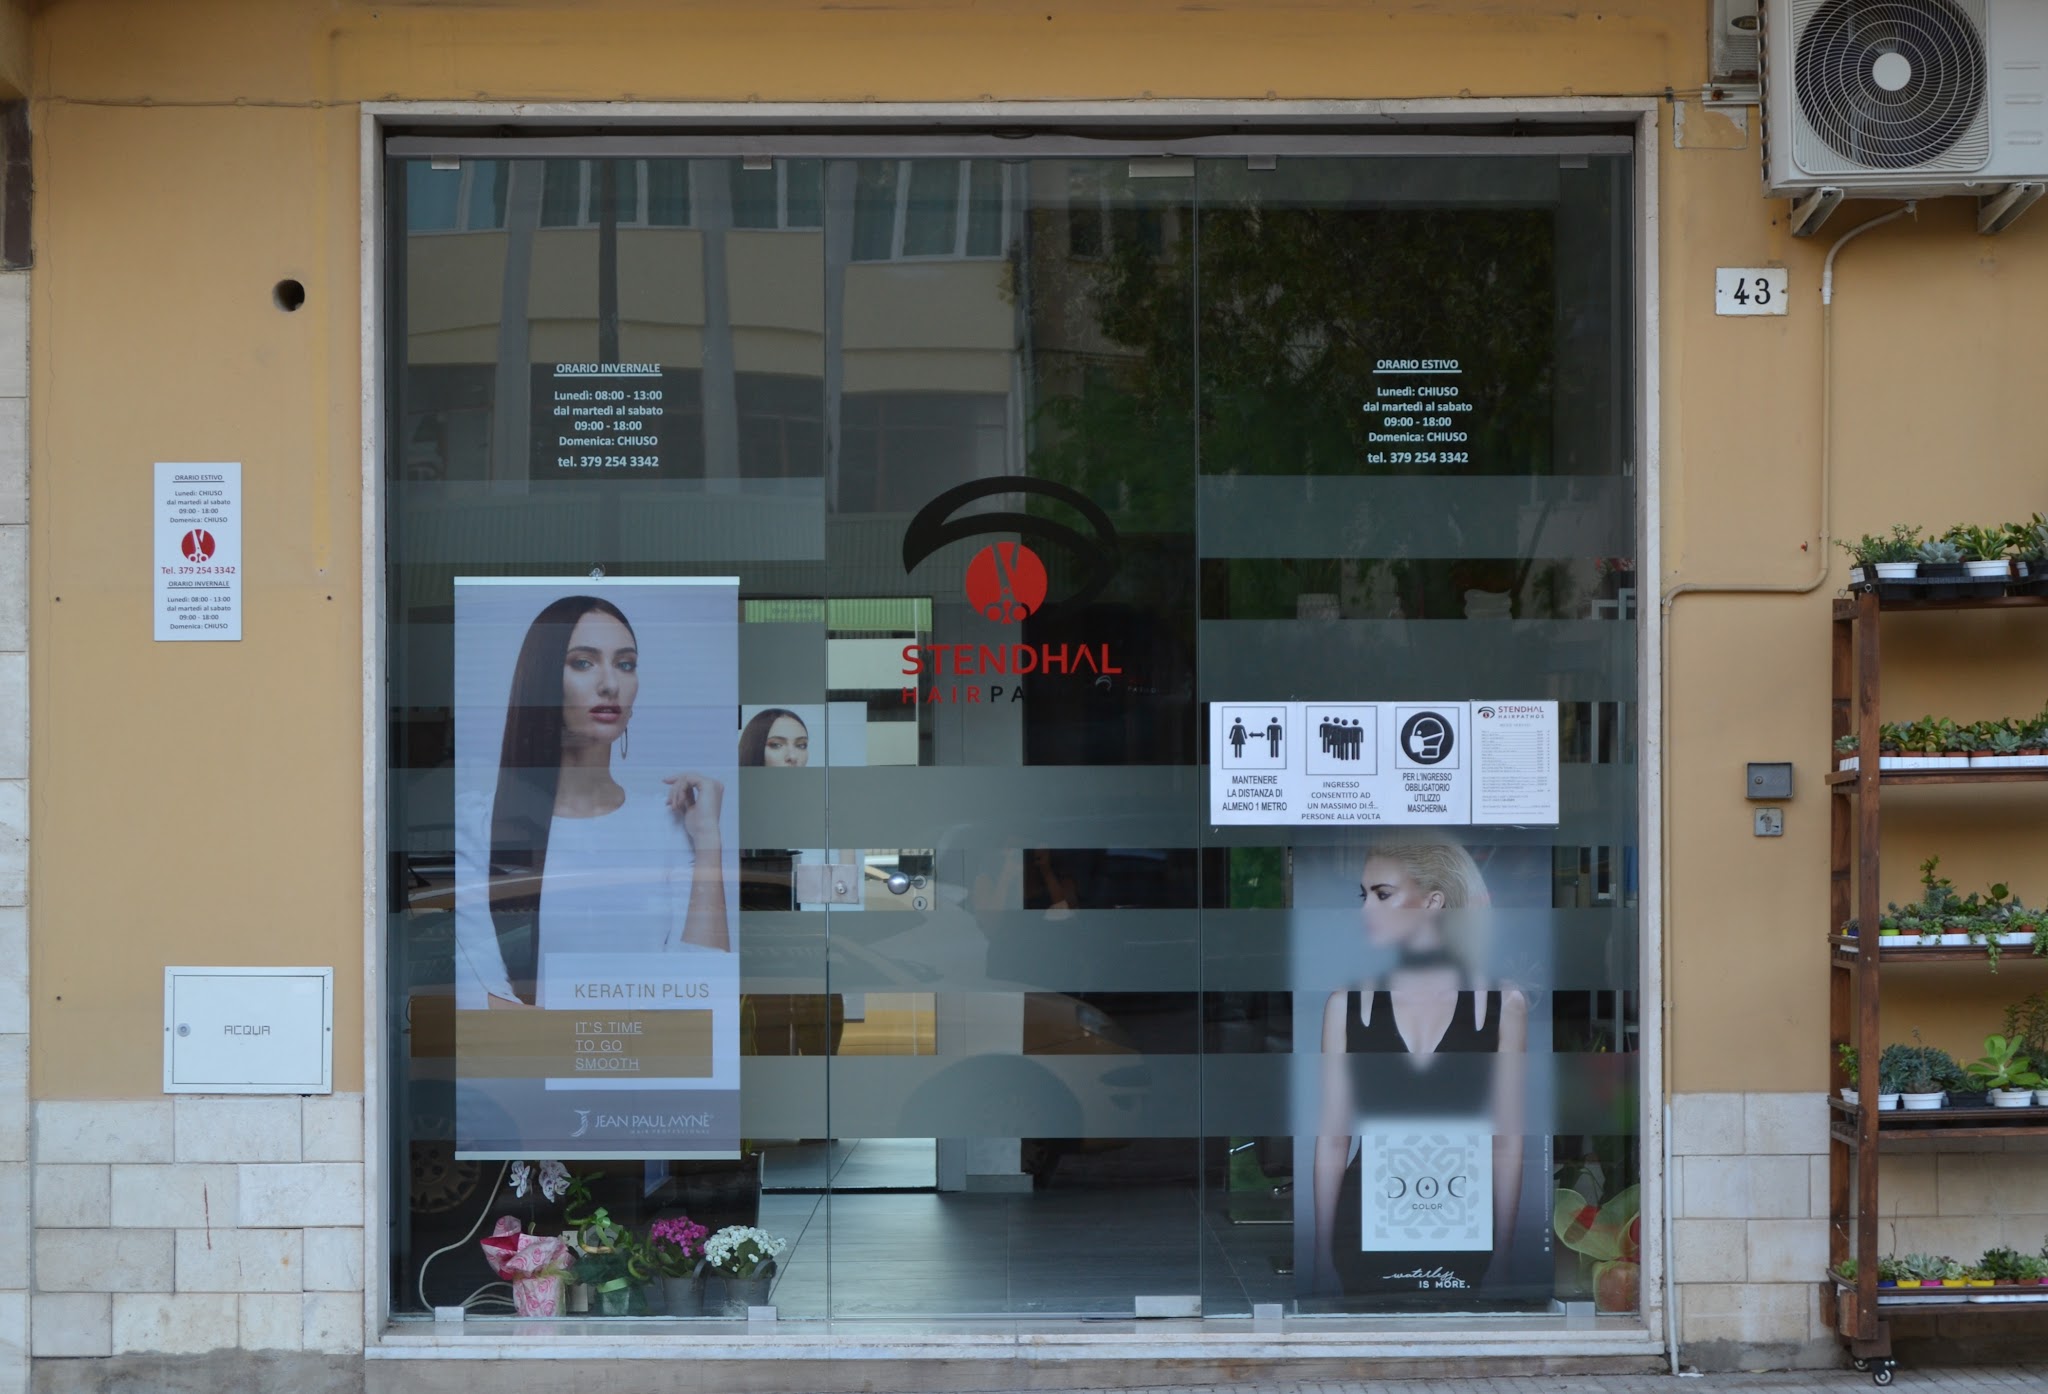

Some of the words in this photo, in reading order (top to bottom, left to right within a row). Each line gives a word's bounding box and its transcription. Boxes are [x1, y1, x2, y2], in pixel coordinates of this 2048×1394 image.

[1733, 277, 1771, 305] 43
[556, 363, 599, 373] ORARIO
[600, 363, 661, 373] INVERNALE
[1376, 359, 1419, 369] ORARIO
[1421, 359, 1459, 369] ESTIVO
[554, 390, 593, 401] Lunedì:
[594, 390, 624, 400] 08:00
[633, 390, 663, 400] 13:00
[1377, 386, 1416, 397] Lunedì:
[1417, 386, 1459, 396] CHIUSO
[553, 405, 570, 416] dal
[572, 405, 614, 416] martedì
[615, 405, 626, 416] al
[627, 405, 664, 416] sabato
[1363, 401, 1379, 412] dal
[1381, 401, 1423, 412] martedì
[1425, 401, 1435, 412] al
[1437, 401, 1473, 412] sabato
[574, 421, 604, 431] 09:00
[612, 421, 643, 431] 18:00
[1384, 416, 1414, 427] 09:00
[1422, 416, 1452, 427] 18:00
[558, 436, 615, 446] Domenica:
[616, 436, 658, 446] CHIUSO
[1368, 431, 1424, 442] Domenica:
[1426, 431, 1468, 442] CHIUSO
[557, 456, 577, 468] tel.
[580, 456, 602, 467] 379
[604, 456, 627, 467] 254
[629, 456, 660, 467] 3342
[1367, 452, 1387, 463] tel.
[1390, 452, 1412, 463] 379
[1414, 452, 1437, 463] 254
[1439, 452, 1469, 463] 3342
[161, 566, 176, 575] Tel.
[178, 566, 194, 574] 379
[196, 566, 212, 574] 254
[214, 566, 236, 574] 3342
[901, 643, 1123, 675] STENDHAL
[901, 685, 1026, 704] HAIRPA
[1498, 705, 1544, 713] STENDHAL
[1231, 775, 1278, 785] MANTENERE
[1402, 772, 1415, 781] PER
[1416, 772, 1453, 781] L'INGRESSO
[1226, 788, 1237, 798] LA
[1238, 788, 1274, 798] DISTANZA
[1275, 788, 1283, 798] DI
[1404, 783, 1450, 792] OBBLIGATORIO
[1311, 791, 1358, 799] CONSENTITO
[1360, 791, 1371, 799] AD
[1414, 793, 1441, 802] UTILIZZO
[1222, 801, 1254, 811] ALMENO
[1261, 801, 1288, 811] METRO
[1320, 802, 1358, 810] MASSIMO
[1407, 804, 1448, 813] MASCHERINA
[575, 983, 656, 998] KERATIN
[663, 983, 710, 998] PLUS
[224, 1025, 271, 1036] ACQUA
[575, 1021, 603, 1033] IT'S
[608, 1021, 643, 1033] TIME
[575, 1039, 595, 1052] TO
[600, 1039, 623, 1052] GO
[575, 1057, 640, 1070] SMOOTH
[594, 1115, 629, 1128] JEAN
[632, 1115, 666, 1128] PAUL
[1418, 1280, 1430, 1289] IS
[1435, 1280, 1471, 1289] MORE.
